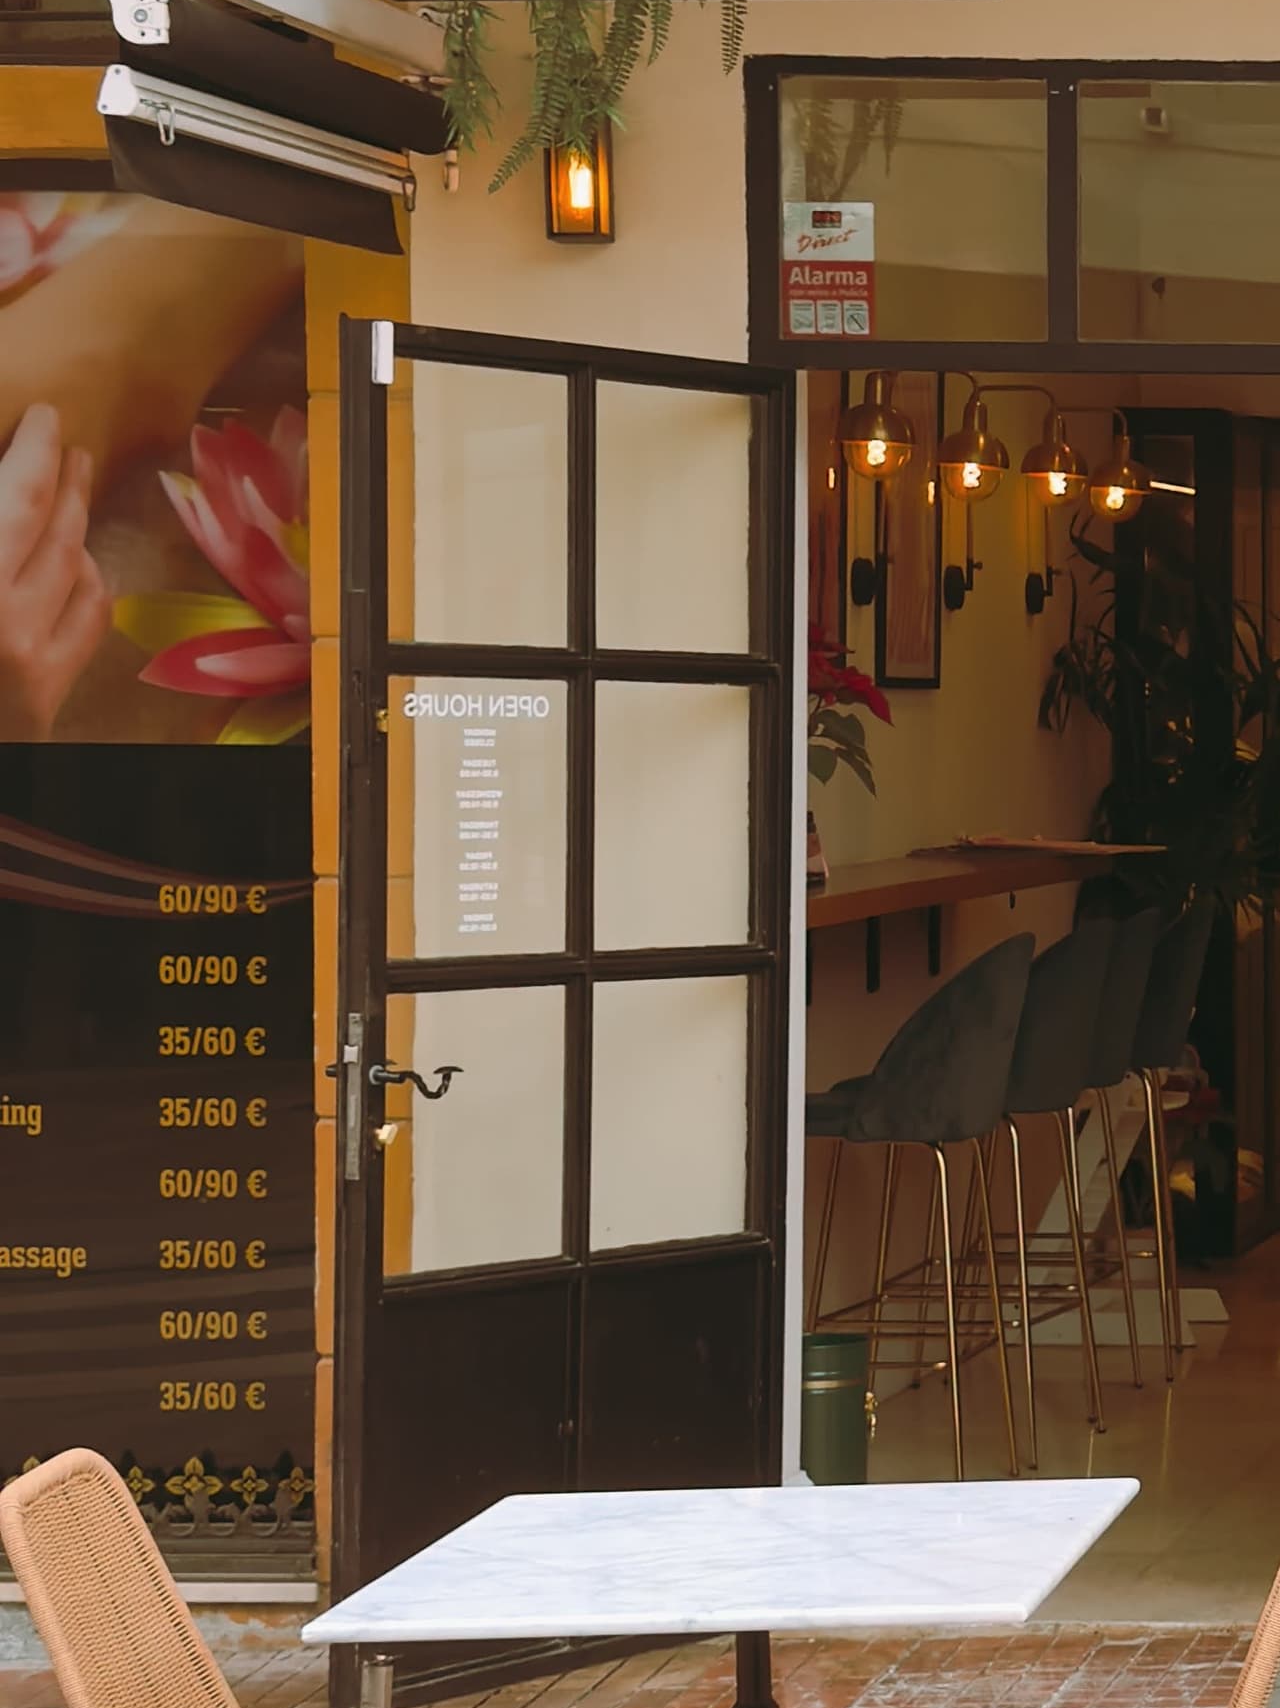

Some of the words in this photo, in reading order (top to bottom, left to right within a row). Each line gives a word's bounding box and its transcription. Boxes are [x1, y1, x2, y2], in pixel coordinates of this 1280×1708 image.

[789, 266, 868, 285] Alarma
[158, 884, 238, 914] 60/90
[245, 884, 268, 914] €
[158, 955, 238, 985] 60/90
[245, 955, 268, 985] €
[158, 1026, 238, 1056] 35/60
[245, 1026, 268, 1056] €
[158, 1097, 238, 1127] 35/60
[245, 1097, 268, 1127] €
[158, 1169, 238, 1199] 60/90
[245, 1169, 268, 1199] €
[0, 1246, 87, 1278] assage
[158, 1240, 238, 1270] 35/60
[245, 1240, 268, 1270] €
[158, 1311, 238, 1341] 60/90
[245, 1311, 268, 1341] €
[158, 1382, 238, 1412] 35/60
[245, 1382, 268, 1412] €
